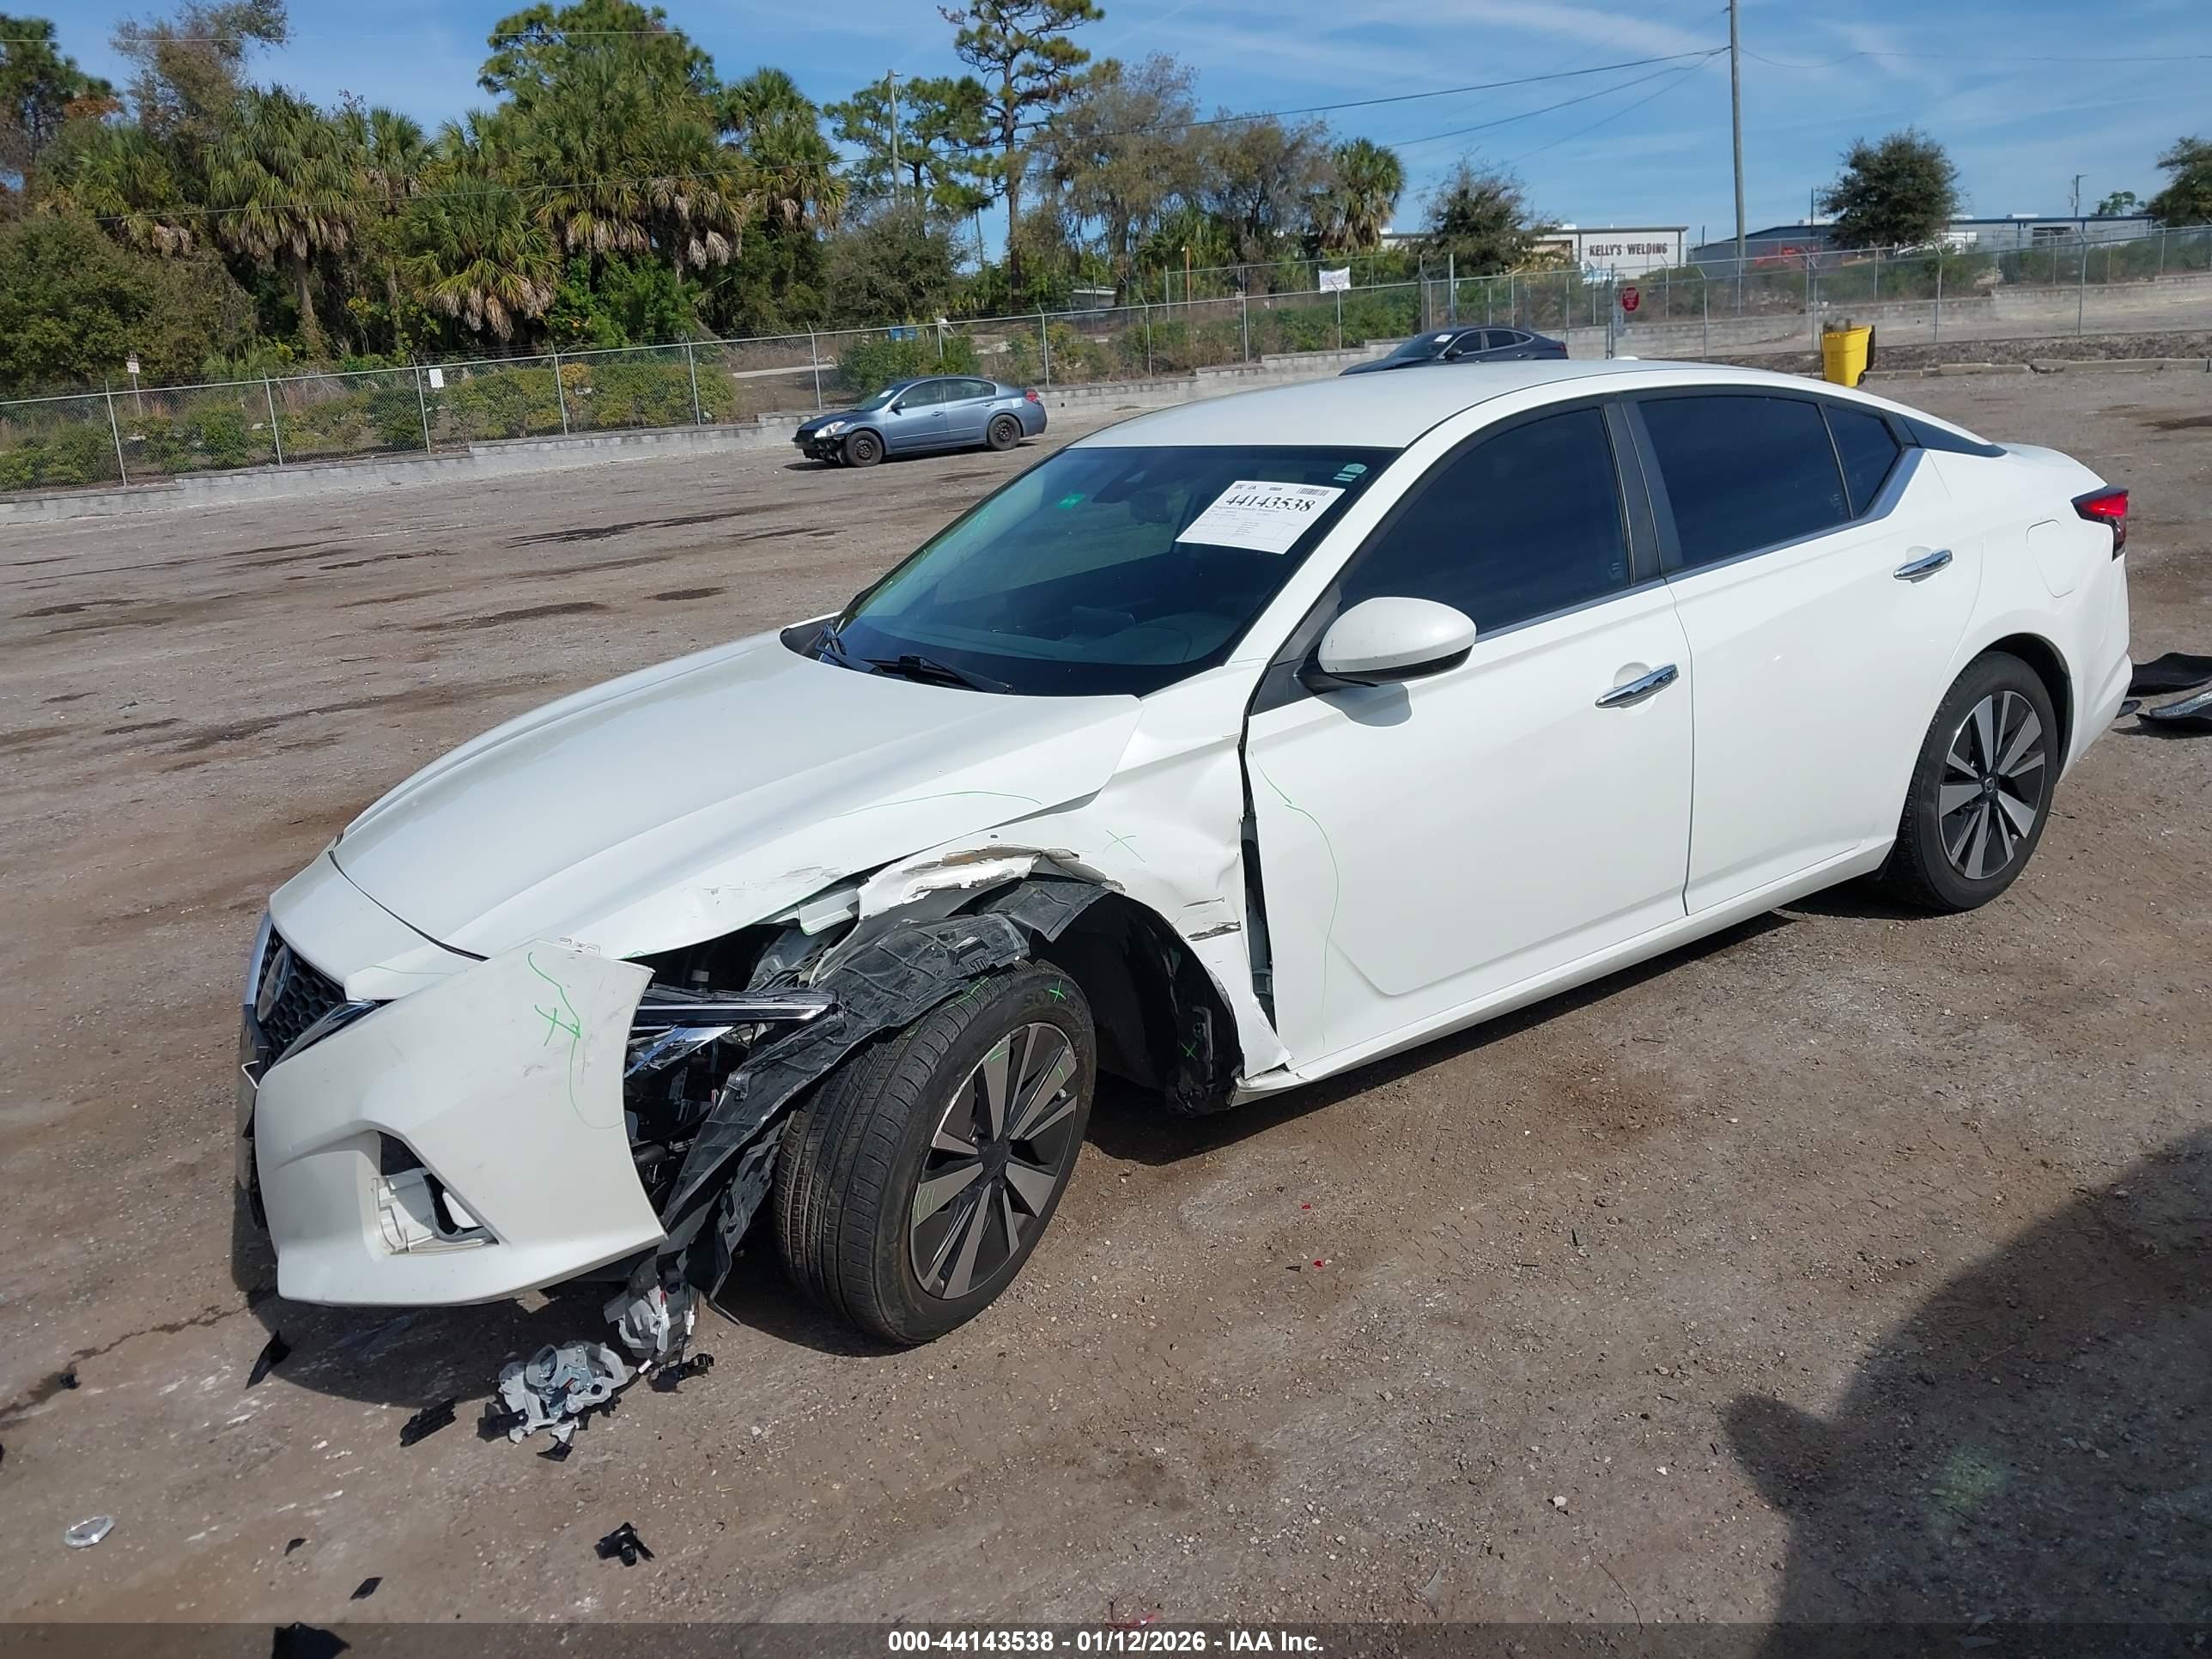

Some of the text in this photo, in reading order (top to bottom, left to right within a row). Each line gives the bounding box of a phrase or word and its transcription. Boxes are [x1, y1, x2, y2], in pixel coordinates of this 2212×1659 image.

[1589, 243, 1668, 257] KELLY'S WELDING
[1225, 494, 1316, 513] 44143538
